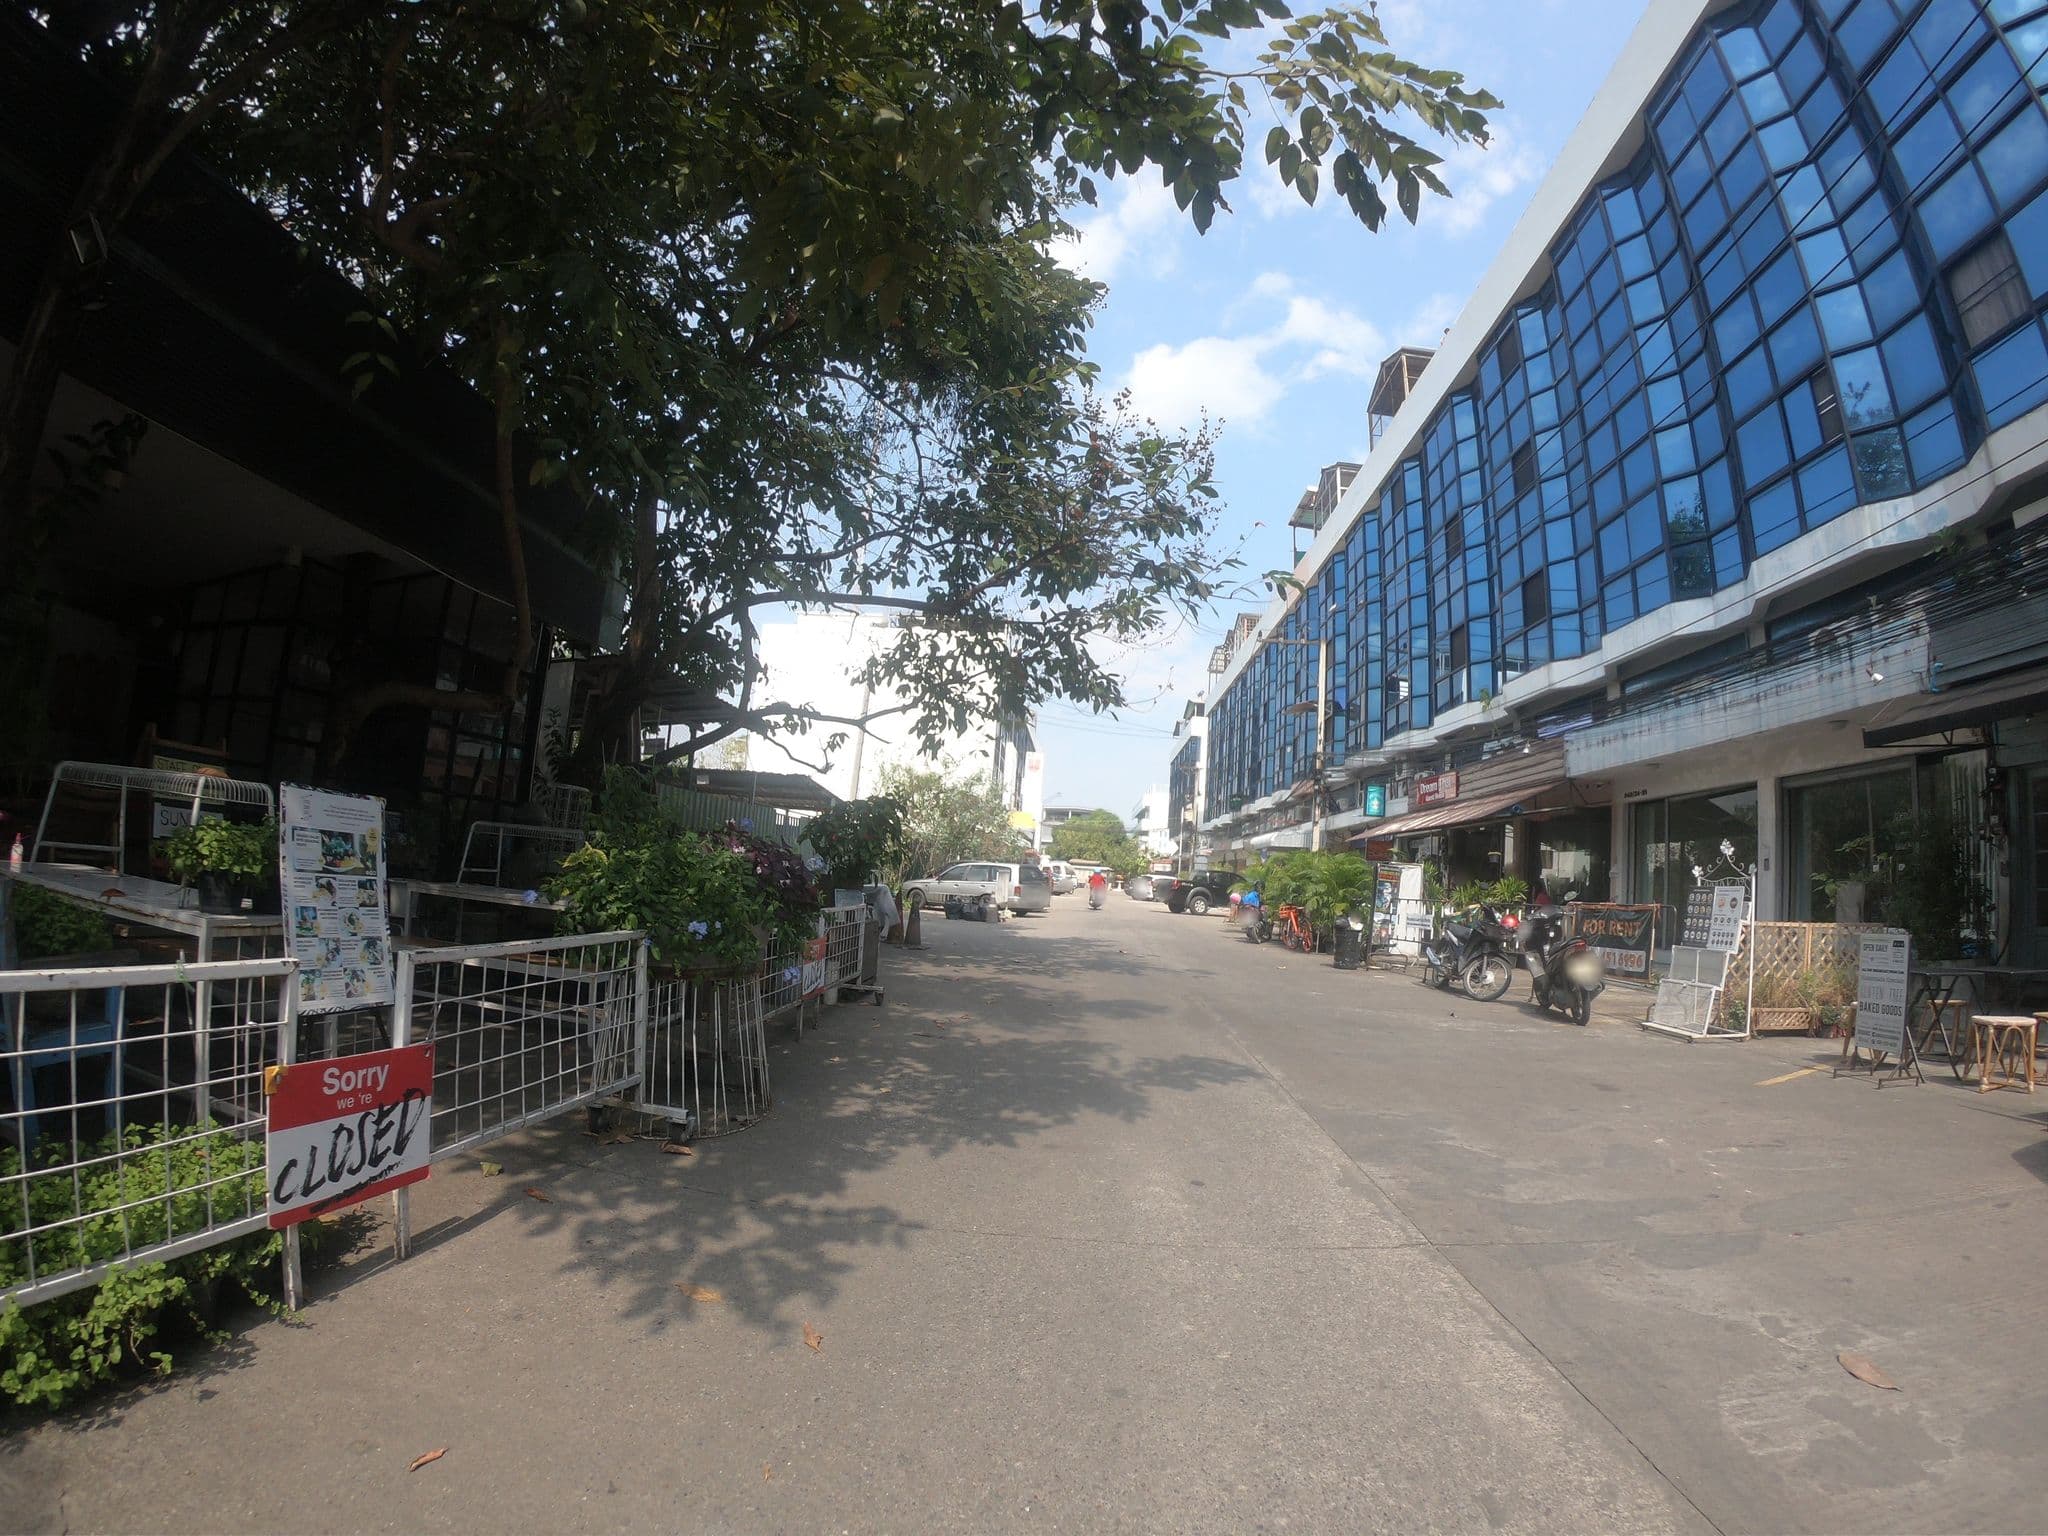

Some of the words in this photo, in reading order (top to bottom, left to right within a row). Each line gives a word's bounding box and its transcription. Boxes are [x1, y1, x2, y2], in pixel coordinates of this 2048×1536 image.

[1582, 919, 1606, 935] FOR
[1608, 920, 1642, 937] RENT
[1863, 943, 1875, 951] OPEN
[1859, 1001, 1880, 1013] BAKED
[1881, 1004, 1902, 1016] GOODS
[322, 1064, 389, 1095] Sorry
[337, 1098, 354, 1110] we
[273, 1087, 426, 1204] CLOSED
